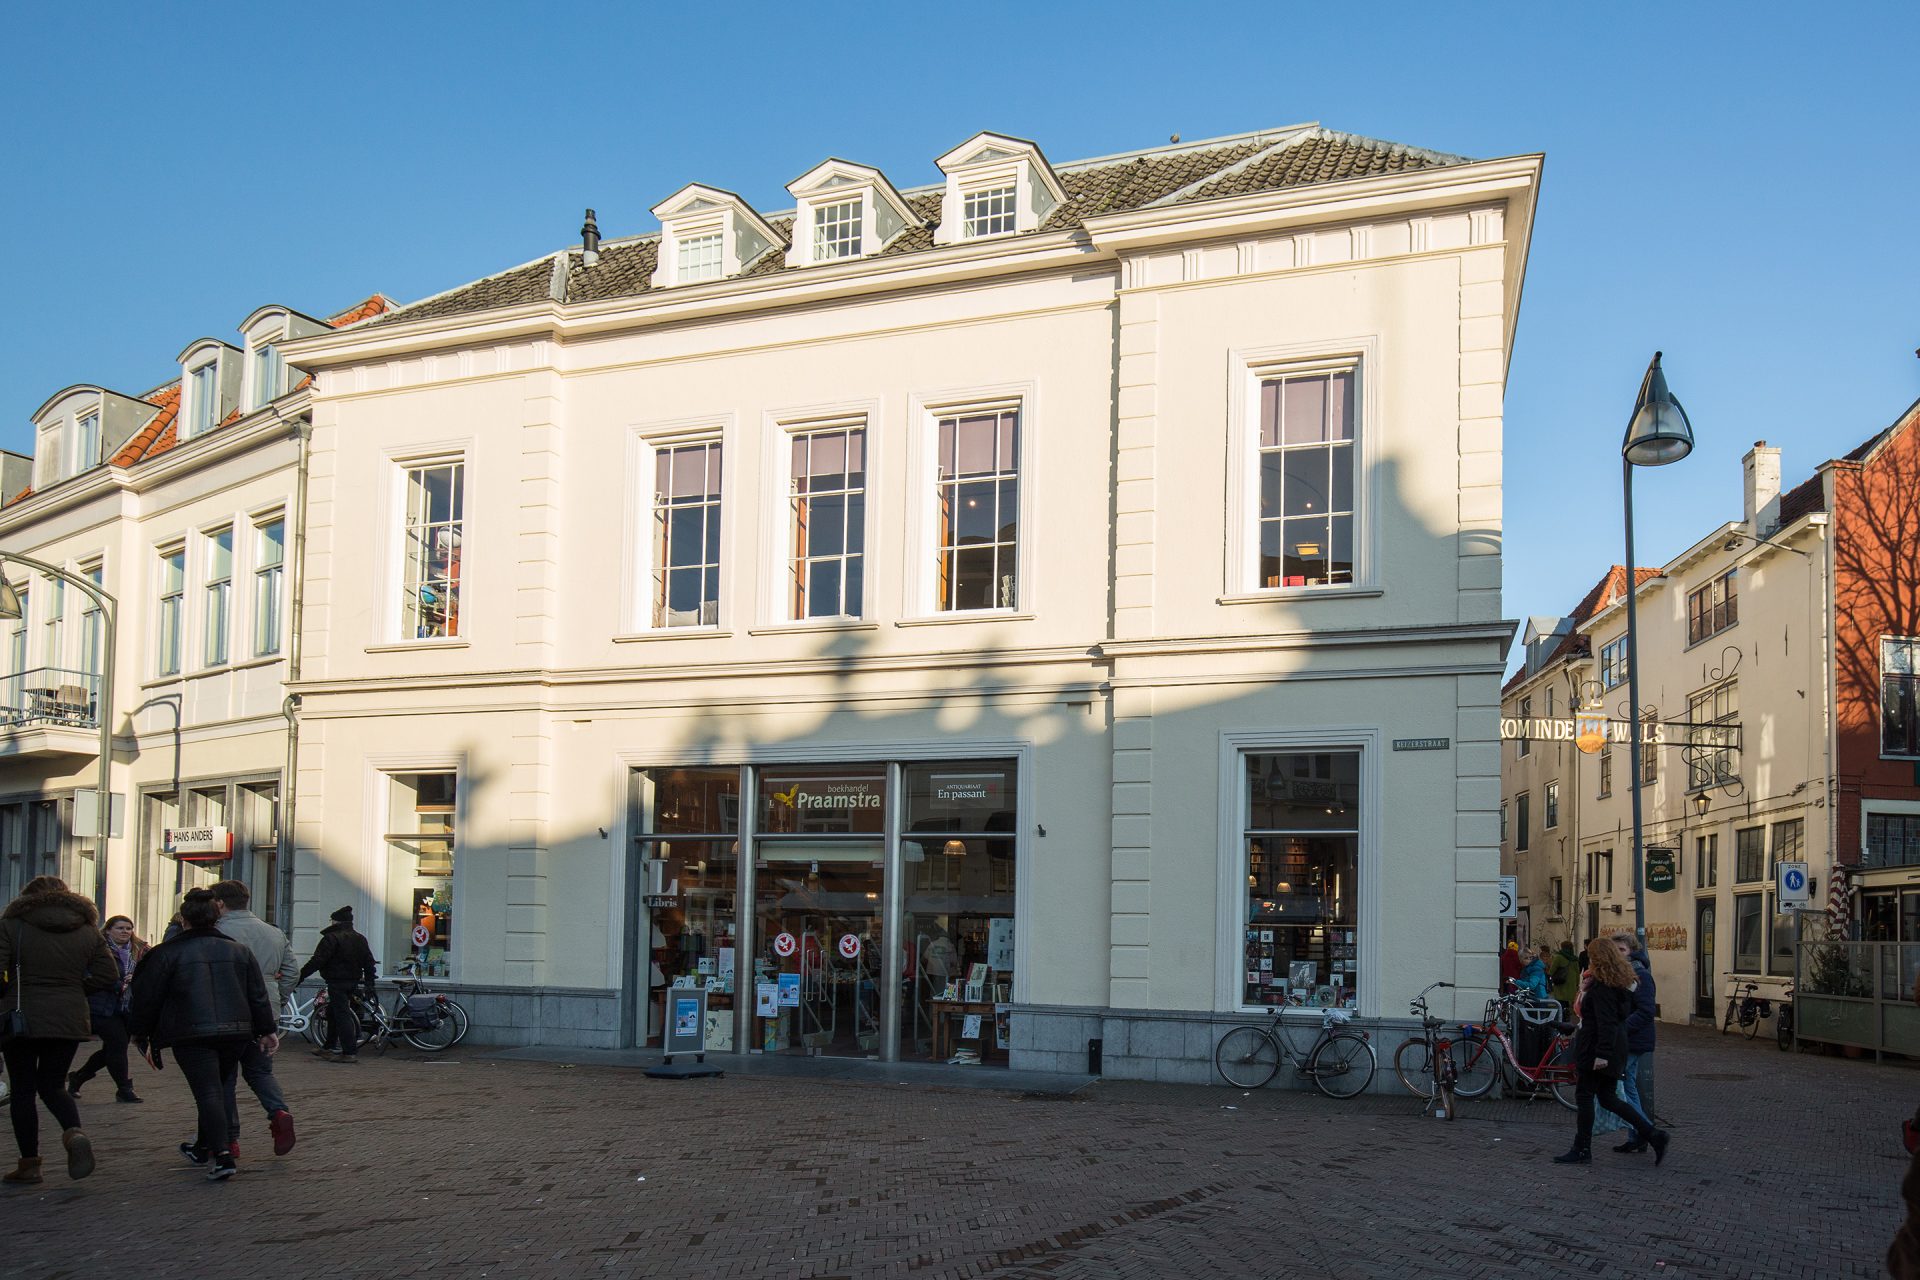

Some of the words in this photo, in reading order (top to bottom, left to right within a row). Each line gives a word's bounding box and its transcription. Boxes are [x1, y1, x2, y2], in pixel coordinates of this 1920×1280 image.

[1535, 719, 1552, 739] IN
[1554, 720, 1575, 740] DE
[827, 784, 869, 793] boekhandel
[797, 791, 881, 809] Praamstra
[937, 789, 950, 799] En
[952, 789, 987, 801] passant
[173, 831, 189, 842] HANS
[190, 829, 213, 841] ANDERS
[648, 897, 678, 907] Libris
